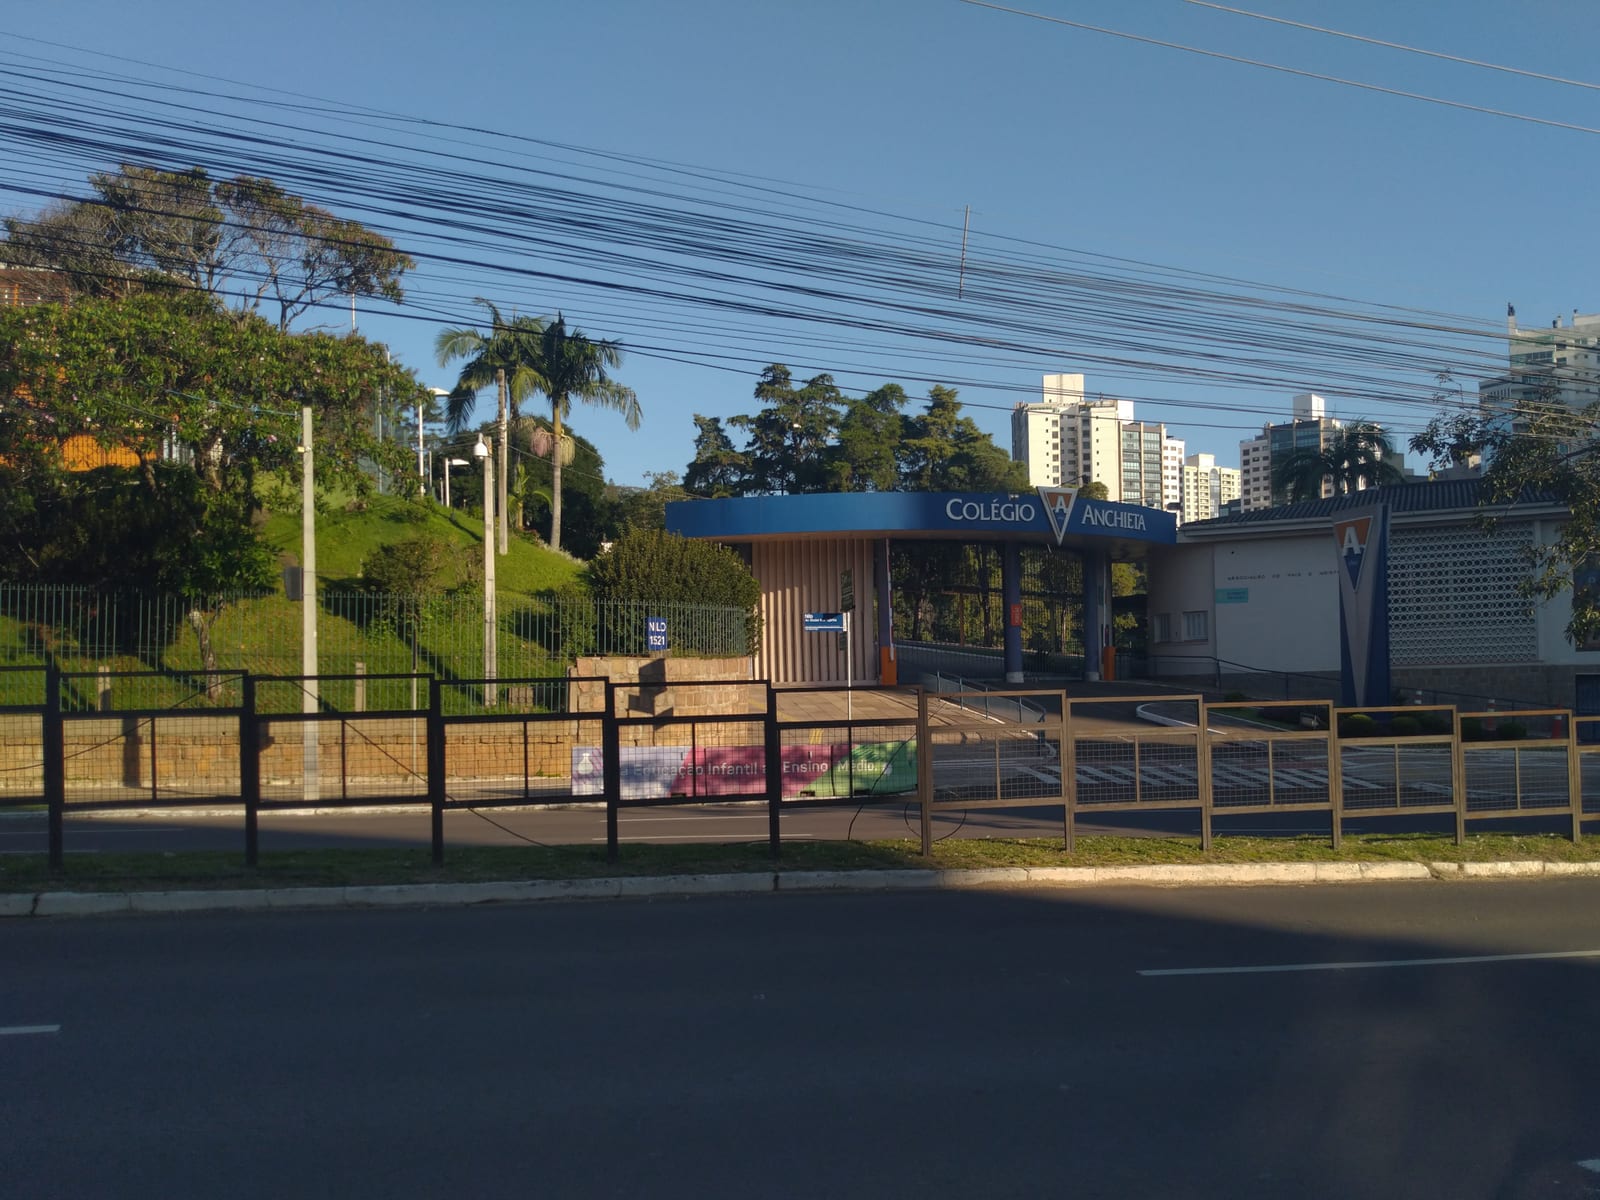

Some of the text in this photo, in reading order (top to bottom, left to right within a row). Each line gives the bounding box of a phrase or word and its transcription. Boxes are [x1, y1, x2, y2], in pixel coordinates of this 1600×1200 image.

[946, 498, 1146, 531] COLÉGIO ANCHIETA
[649, 635, 665, 646] 1521
[708, 762, 758, 775] Infantil
[783, 760, 829, 773] Ensino
